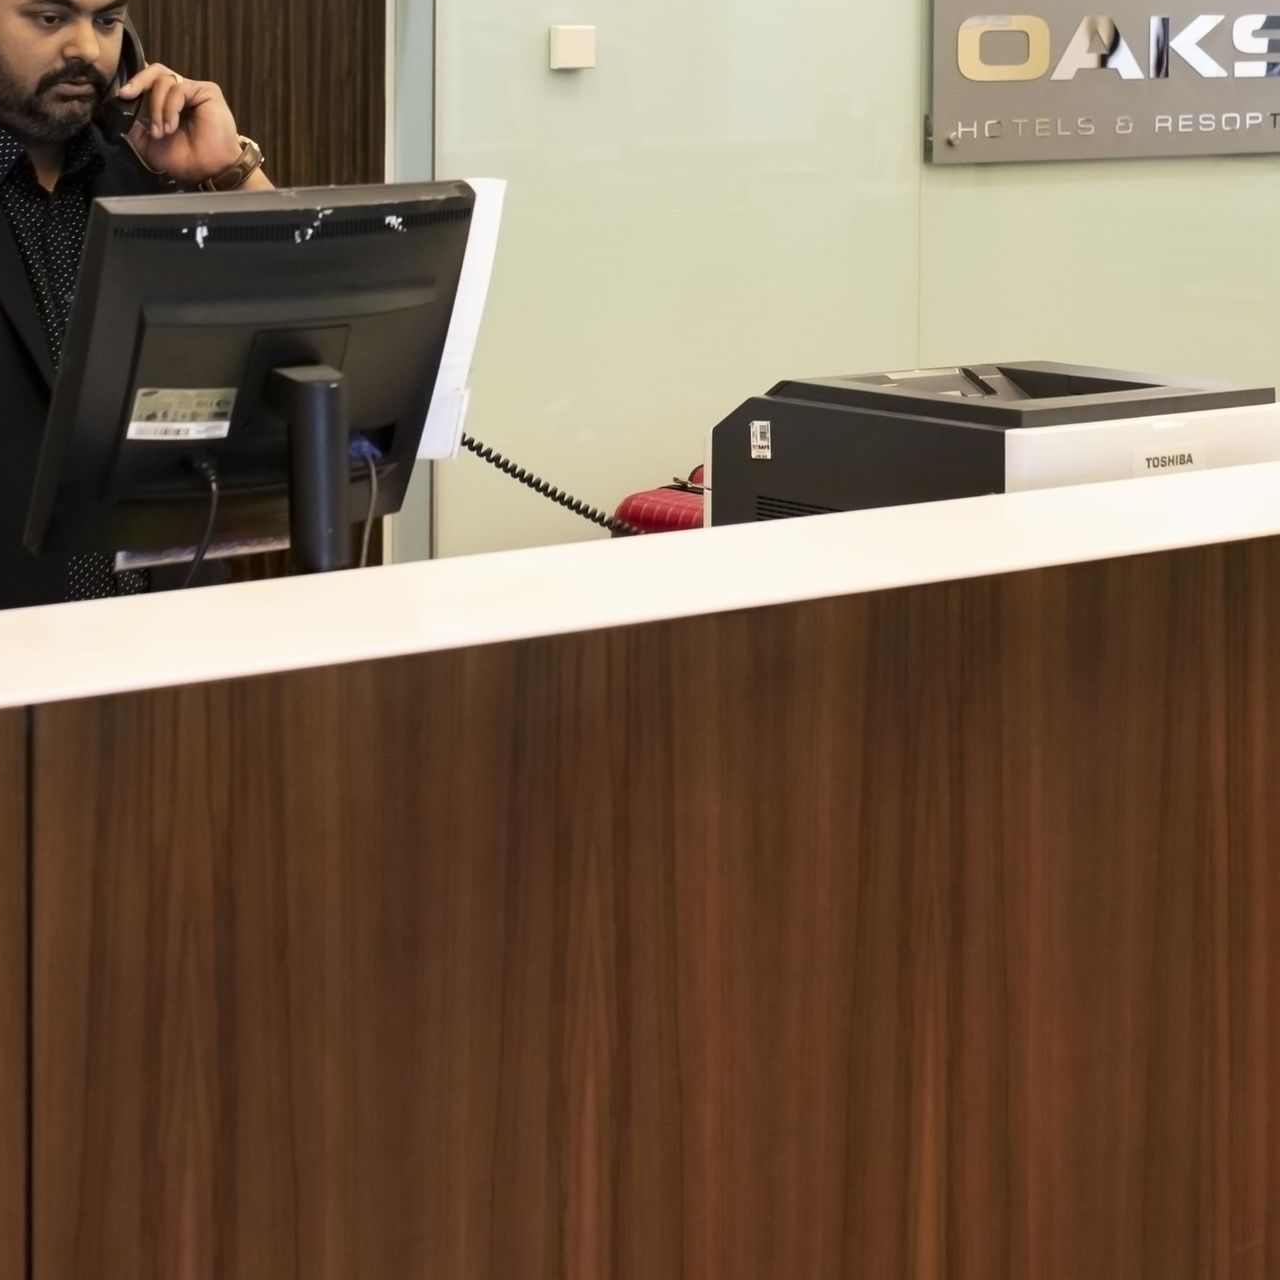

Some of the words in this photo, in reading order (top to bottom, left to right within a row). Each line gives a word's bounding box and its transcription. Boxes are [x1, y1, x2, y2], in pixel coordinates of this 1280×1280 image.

[957, 116, 1095, 139] HOTELS
[1115, 116, 1133, 134] &
[1145, 452, 1193, 469] TOSHIBA
